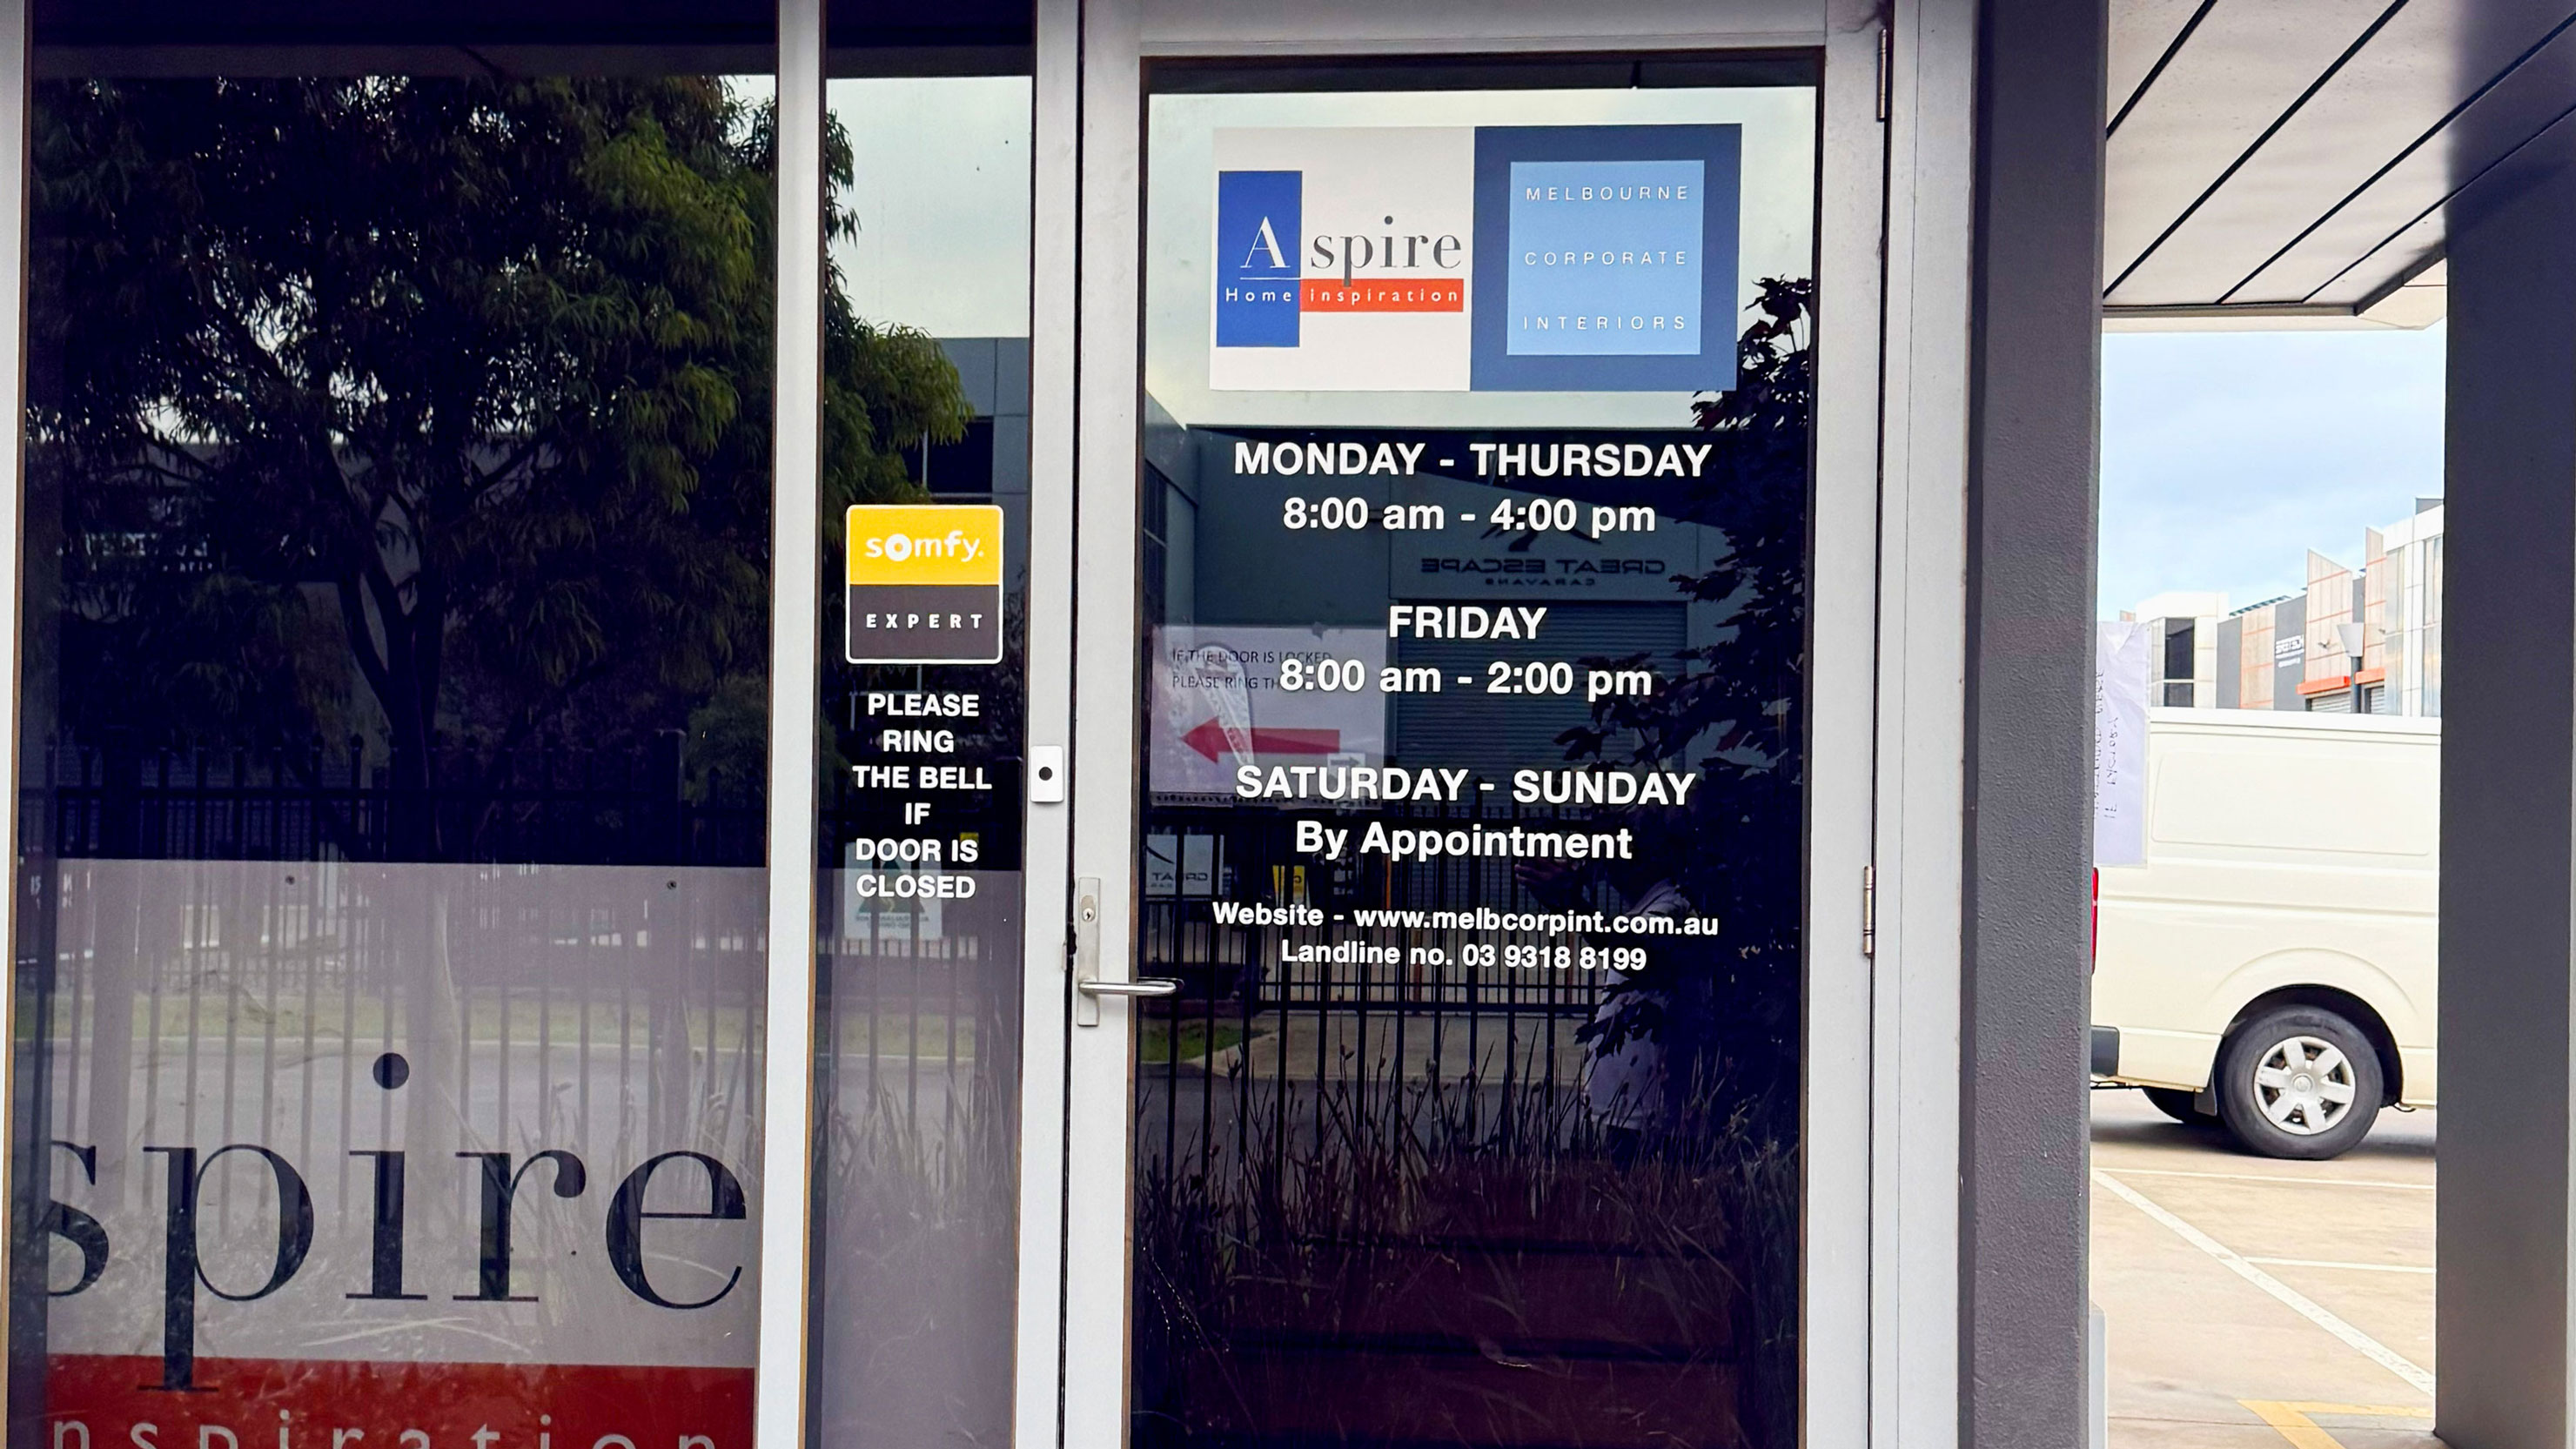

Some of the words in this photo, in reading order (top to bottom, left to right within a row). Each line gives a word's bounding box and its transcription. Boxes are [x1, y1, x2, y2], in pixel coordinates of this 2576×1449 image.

[1525, 185, 1688, 202] MELBOURNE
[1524, 251, 1687, 266] CORPORATE
[1224, 287, 1292, 303] Home
[1310, 287, 1459, 306] inspiration
[1523, 315, 1686, 331] INTERIORS
[1234, 441, 1426, 476] MONDAY
[1439, 458, 1454, 467] -
[1468, 442, 1714, 478] THURSDAY
[1282, 496, 1369, 531] 8:00
[1382, 504, 1445, 531] am
[1460, 513, 1476, 522] -
[1489, 497, 1578, 532] 4:00
[1591, 506, 1656, 540] pm
[866, 613, 983, 629] EXPERT
[1388, 604, 1548, 641] FRIDAY
[1218, 649, 1259, 663] DOOR
[1263, 650, 1275, 663] IS
[1171, 674, 1220, 688] PLEASE
[1224, 675, 1259, 689] RING
[1278, 657, 1366, 693] 8:00
[1379, 666, 1442, 694] am
[1457, 675, 1472, 685] -
[1486, 661, 1574, 695] 2:00
[1587, 669, 1653, 703] pm
[867, 692, 980, 718] PLEASE
[882, 728, 955, 754] RING
[851, 764, 910, 789] THE
[918, 765, 993, 790] BELL
[1235, 763, 1470, 802] SATURDAY
[1479, 782, 1495, 792] -
[1512, 768, 1697, 806] SUNDAY
[904, 802, 932, 826] IF
[855, 837, 942, 862] DOOR
[950, 838, 979, 863] IS
[1295, 819, 1349, 862] By
[1358, 821, 1633, 863] Appointment
[855, 873, 976, 900] CLOSED
[1211, 901, 1325, 927] Website
[1352, 906, 1719, 938] www.melbcorpint.com.au
[1281, 938, 1402, 965] Landline
[1409, 946, 1454, 967] no.
[1461, 943, 1497, 968] 03
[1503, 943, 1572, 970] 9318
[1578, 945, 1647, 971] 8199
